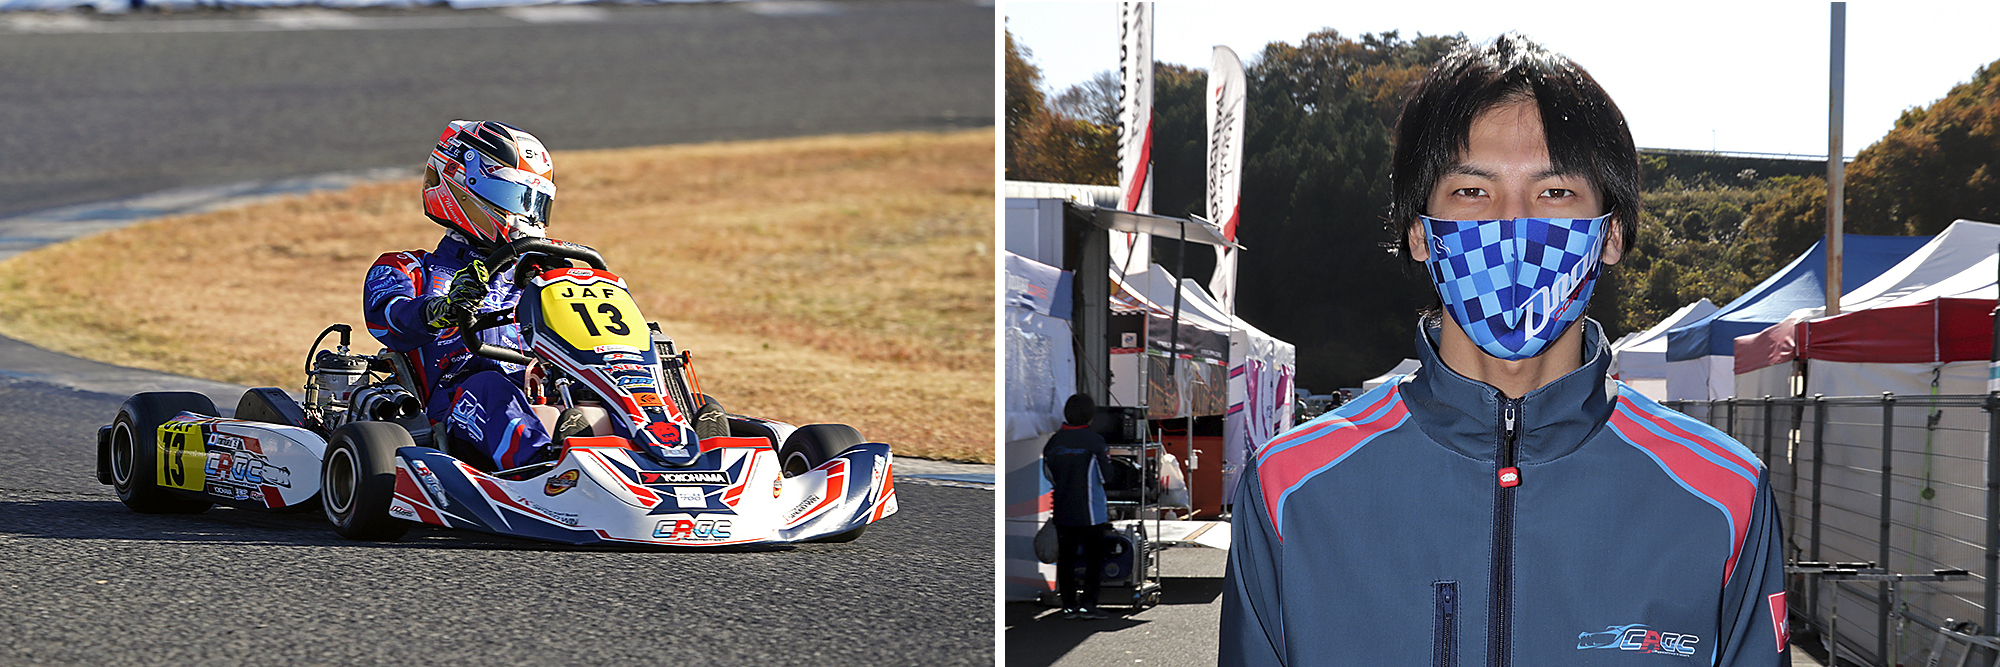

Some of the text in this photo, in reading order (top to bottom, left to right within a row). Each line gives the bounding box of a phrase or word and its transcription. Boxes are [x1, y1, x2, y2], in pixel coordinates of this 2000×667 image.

[561, 288, 614, 299] JAF
[570, 302, 631, 337] 13
[163, 431, 185, 487] 13
[660, 473, 727, 483] YOKOHAMA
